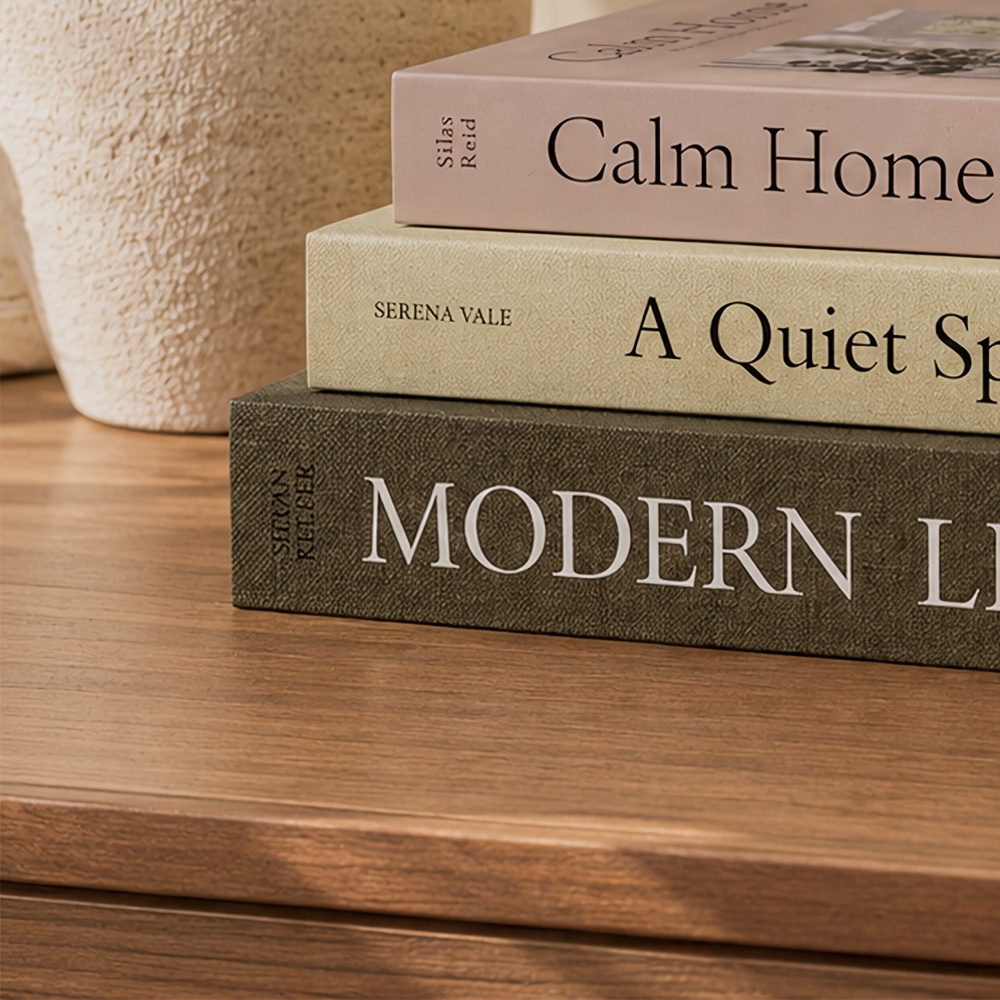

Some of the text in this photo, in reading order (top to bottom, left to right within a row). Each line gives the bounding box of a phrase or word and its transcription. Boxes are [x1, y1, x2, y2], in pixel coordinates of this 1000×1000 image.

[435, 116, 454, 168] Silas
[460, 118, 477, 169] Reid
[547, 115, 995, 205] Calm Home
[374, 301, 512, 327] SERENA VALE
[624, 296, 682, 360] A
[709, 300, 907, 386] Quiet
[361, 476, 862, 600] MODERN
